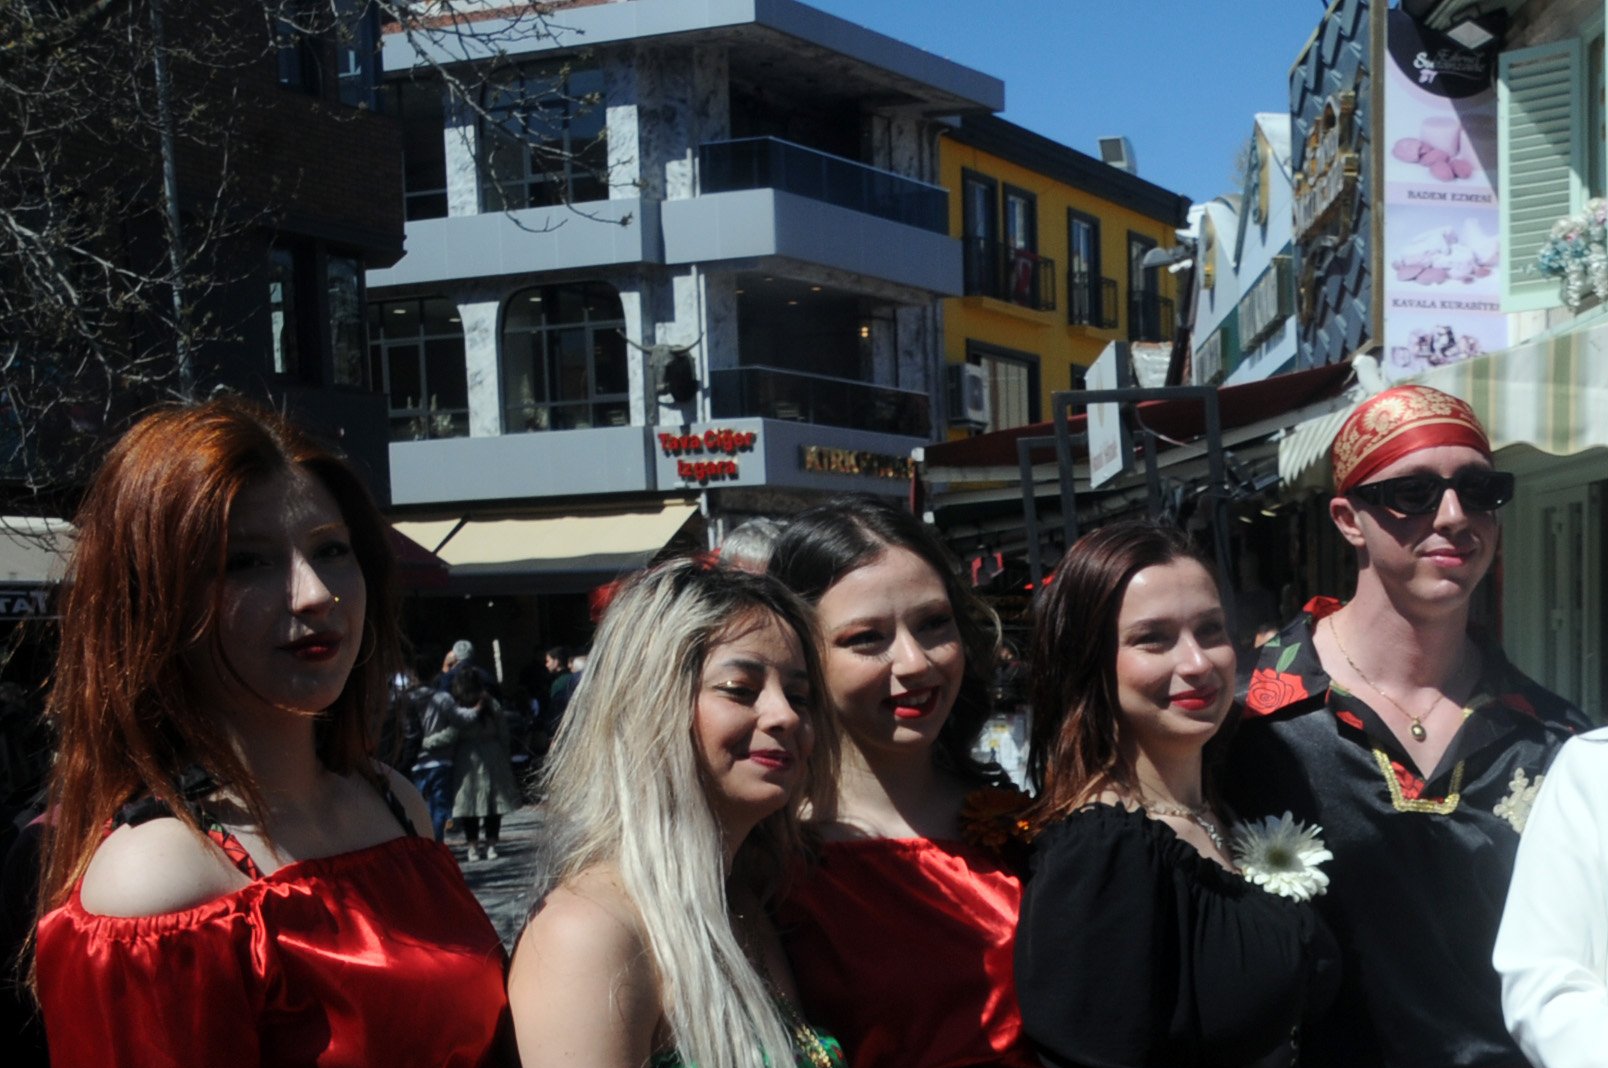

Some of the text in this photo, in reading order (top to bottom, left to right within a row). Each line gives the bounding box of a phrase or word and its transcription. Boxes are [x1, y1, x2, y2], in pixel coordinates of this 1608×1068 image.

[1407, 190, 1447, 201] BADEM
[1391, 298, 1437, 310] KAVALA
[657, 428, 757, 453] Tava Ciğer
